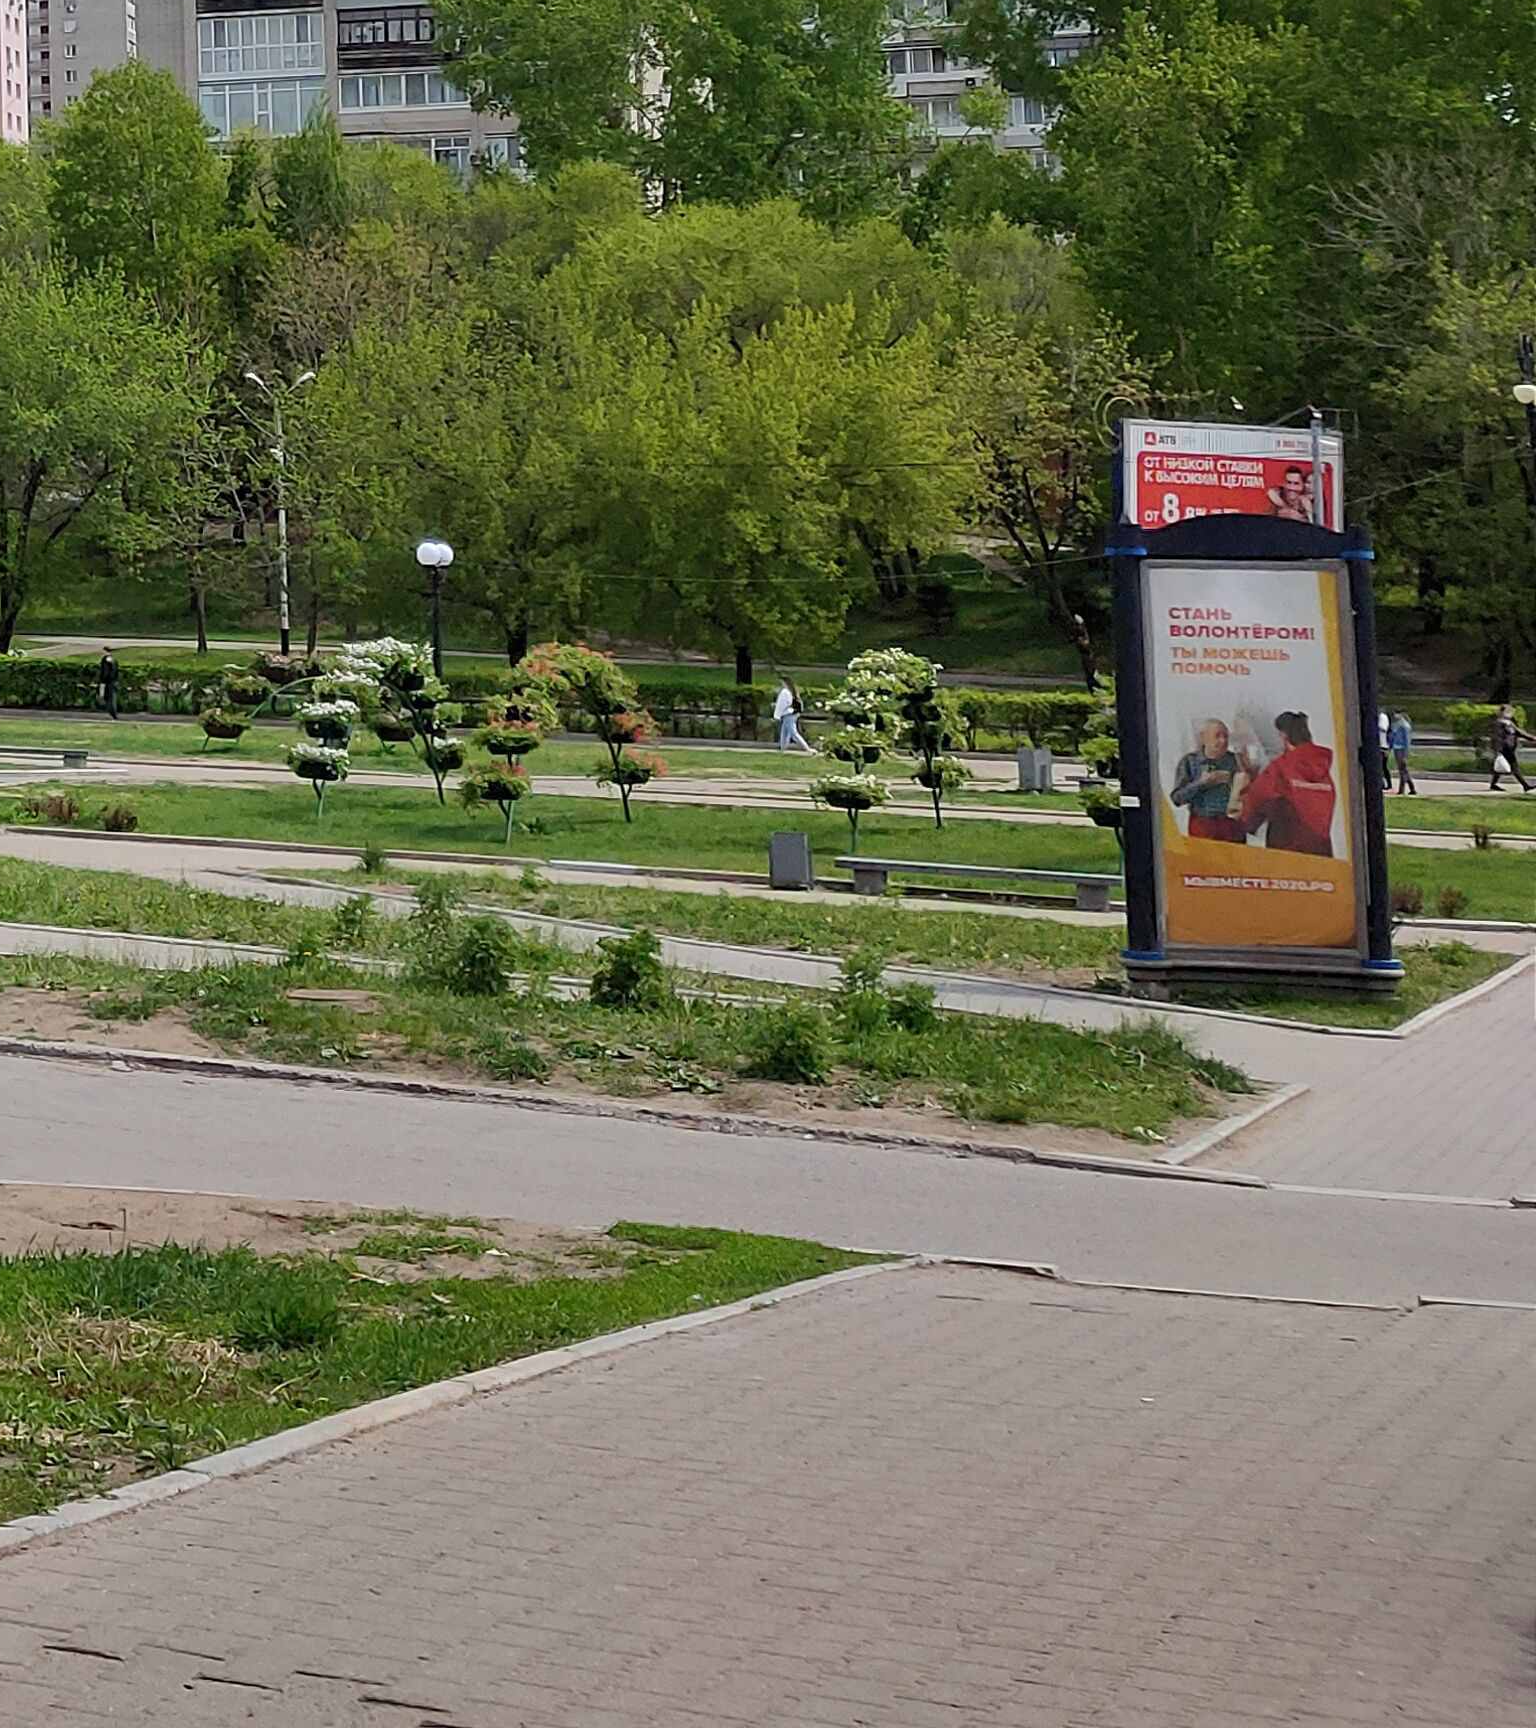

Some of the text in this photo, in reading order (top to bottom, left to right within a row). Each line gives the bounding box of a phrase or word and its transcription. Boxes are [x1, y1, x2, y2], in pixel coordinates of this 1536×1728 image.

[1144, 456, 1263, 474] ОТ НИЗКОЙ СТАВКИ
[1144, 470, 1264, 489] К ВЫСОКИМ ЦЕЛЯМ
[1144, 510, 1159, 522] ОТ
[1168, 607, 1232, 621] СТАНЬ
[1169, 623, 1315, 641] ВОЛОНТЁРОМ!
[1170, 646, 1290, 661] ТЫ МОЖЕШЬ
[1172, 662, 1251, 676] ПОМОЧЬ
